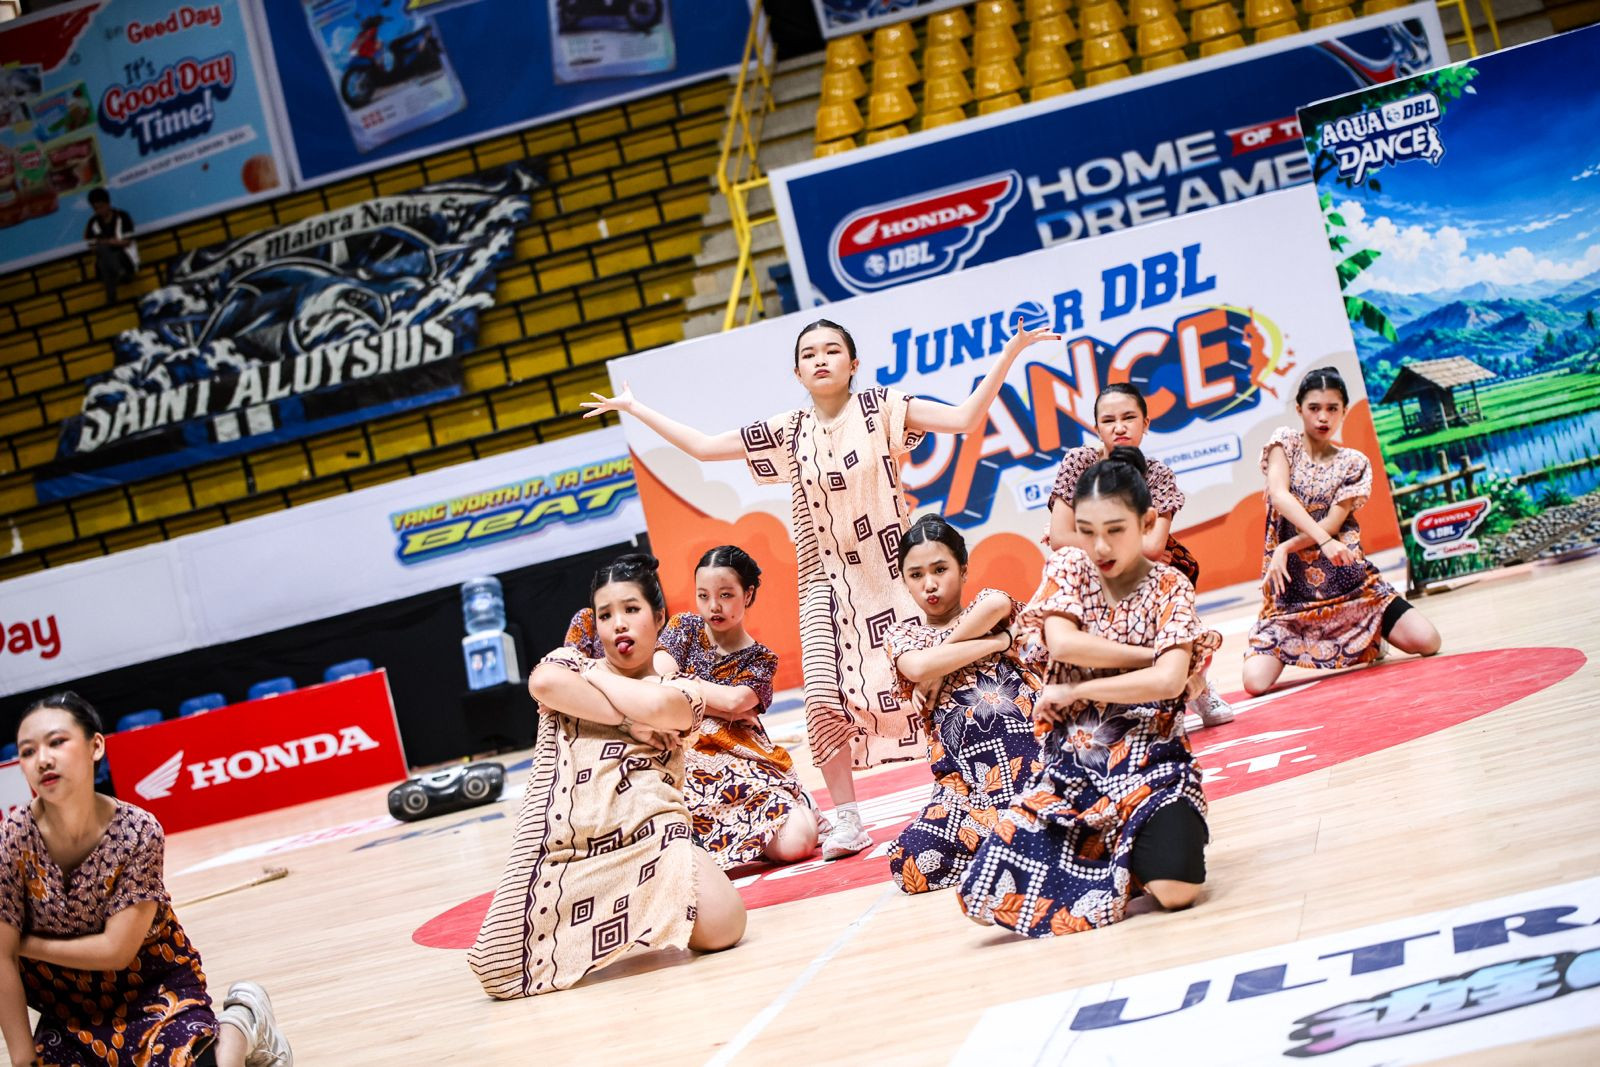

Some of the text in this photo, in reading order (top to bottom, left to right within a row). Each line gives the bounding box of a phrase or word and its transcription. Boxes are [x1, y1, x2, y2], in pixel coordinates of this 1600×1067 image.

[126, 20, 178, 44] Good
[180, 5, 222, 28] Day
[104, 55, 234, 121] Good Day
[124, 57, 156, 86] It's
[135, 88, 214, 144] Time!
[1322, 98, 1436, 147] AQUA DBL
[1026, 130, 1222, 211] HOME
[1241, 127, 1273, 147] OF
[1335, 125, 1429, 185] DANCE
[265, 212, 354, 261] Maiora
[361, 200, 431, 229] Natus
[881, 202, 979, 241] HONDA
[888, 240, 936, 273] DBL
[876, 242, 1217, 387] JUNIOR DBL
[392, 504, 448, 531] YANG
[450, 484, 521, 517] WORTH
[554, 472, 580, 491] YA
[0, 614, 62, 661] ay
[187, 725, 380, 791] HONDA
[1069, 904, 1600, 1031] ULTR
